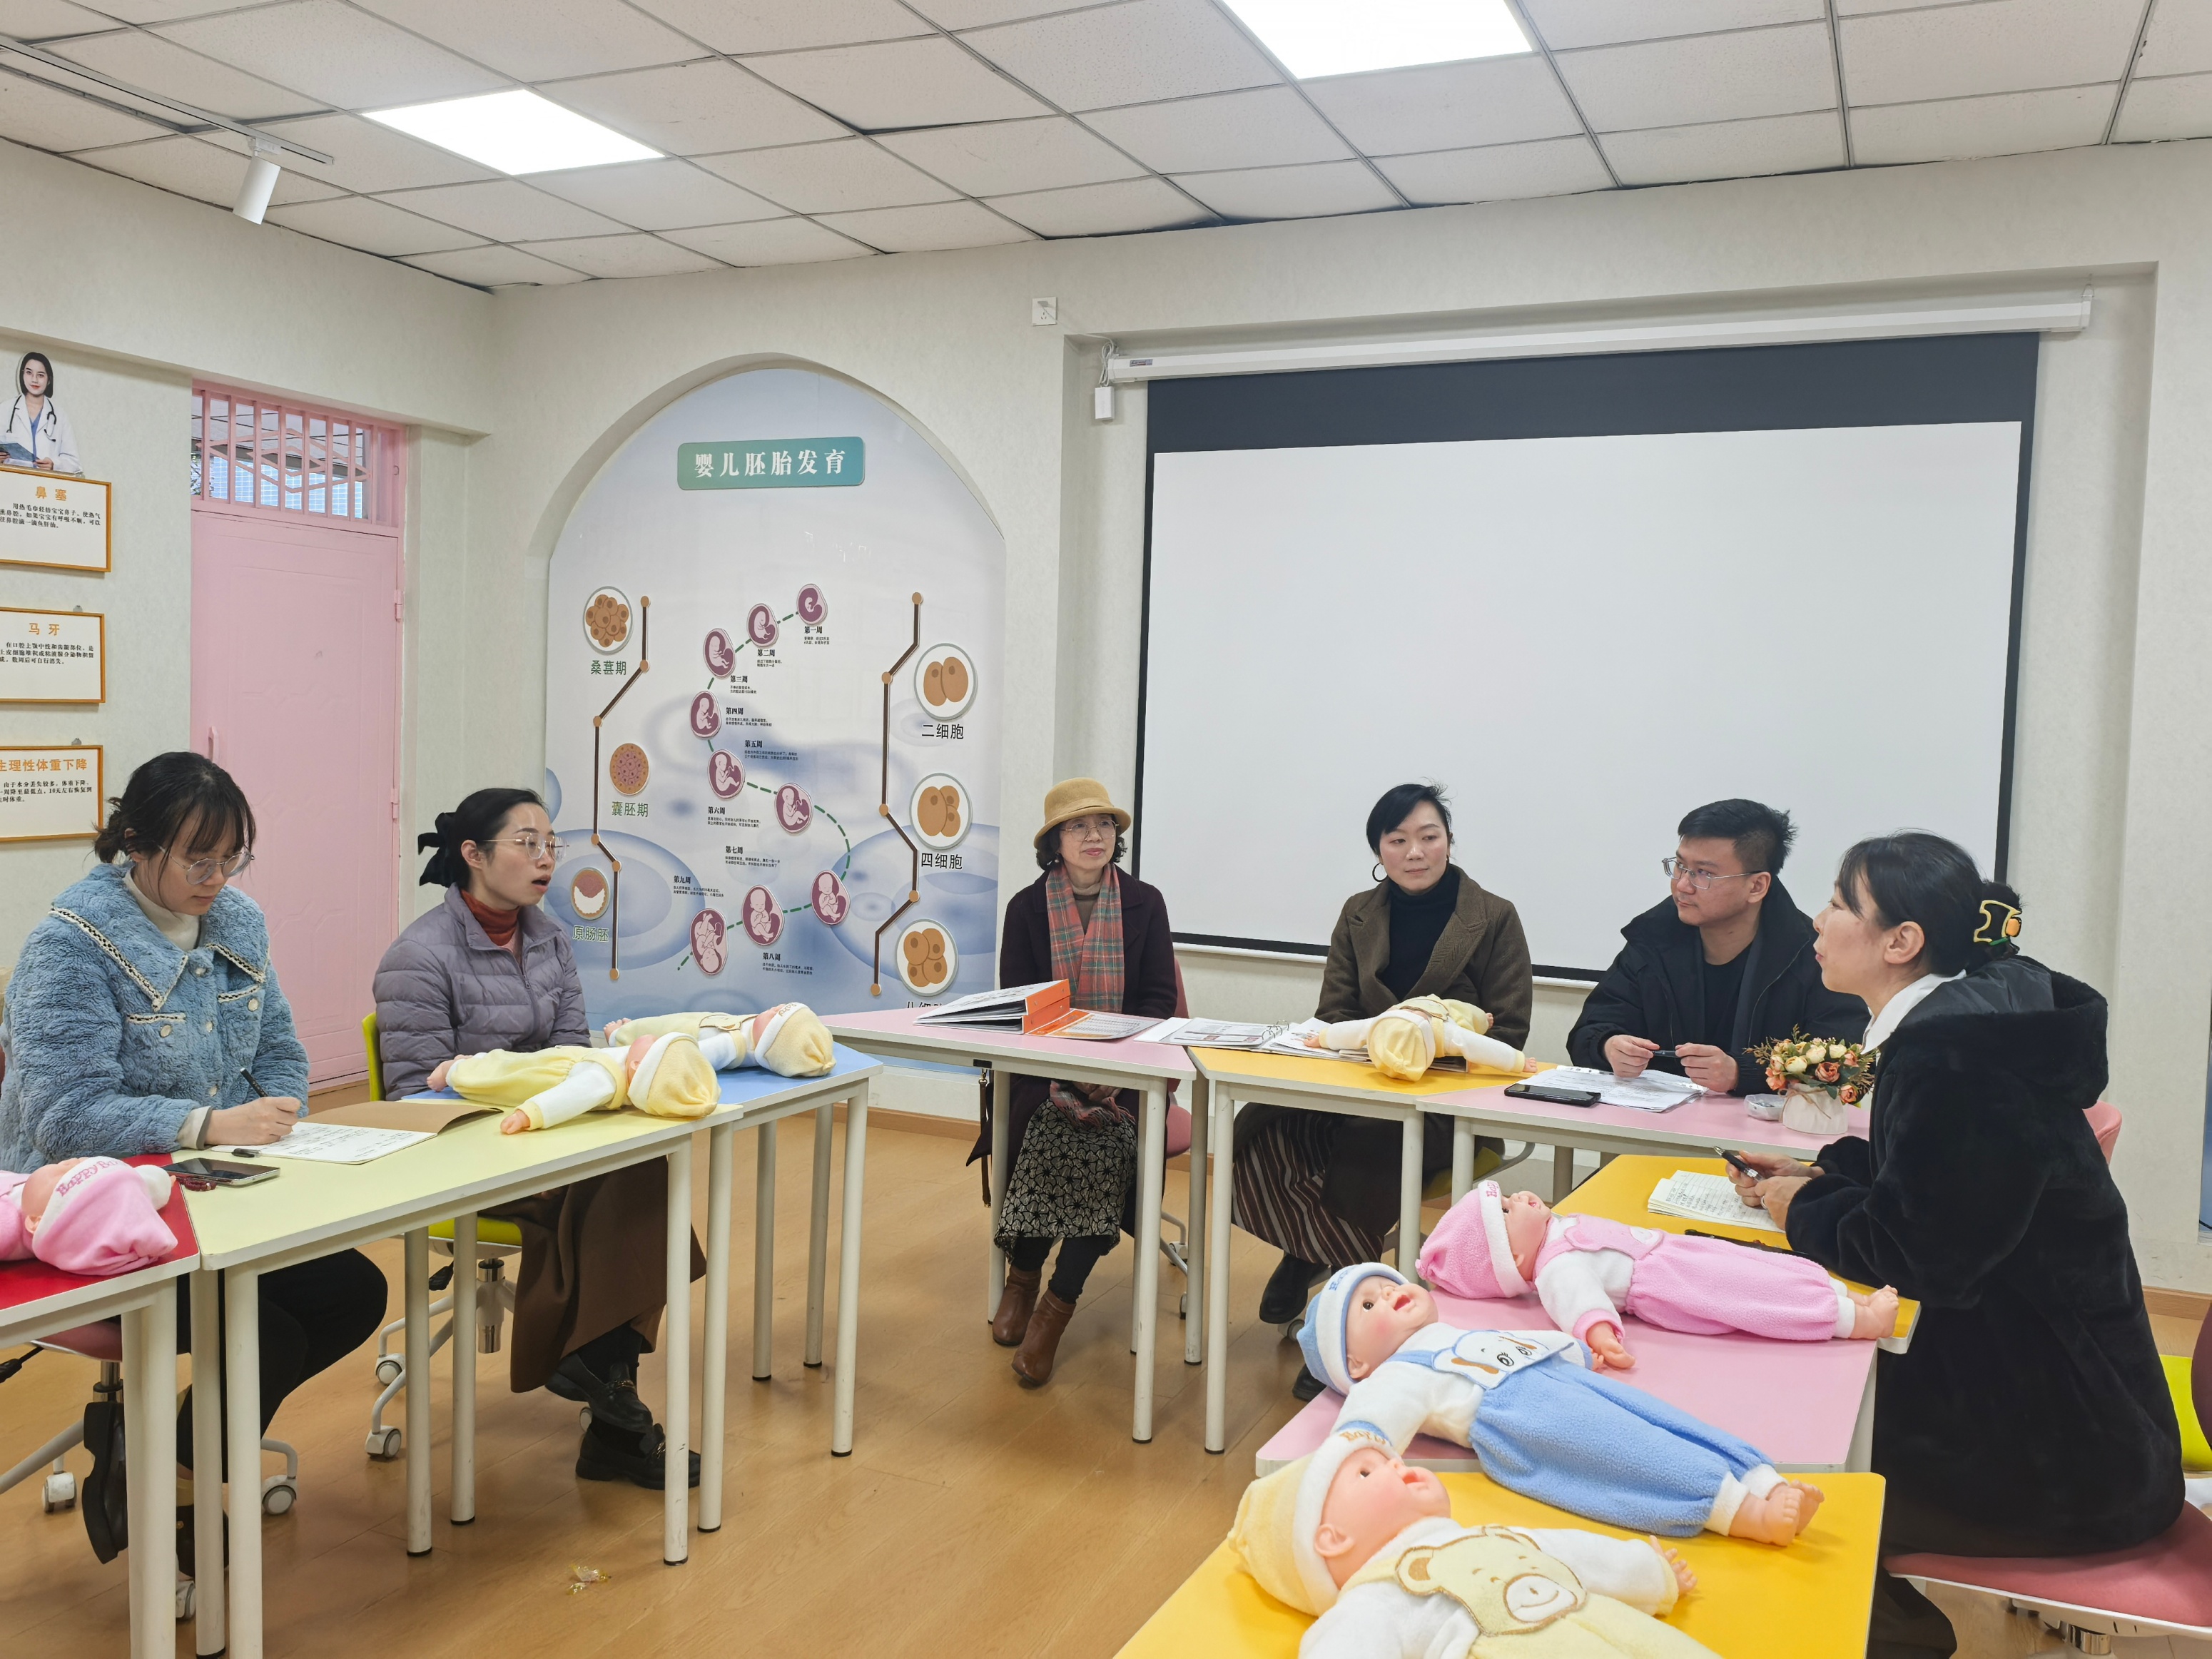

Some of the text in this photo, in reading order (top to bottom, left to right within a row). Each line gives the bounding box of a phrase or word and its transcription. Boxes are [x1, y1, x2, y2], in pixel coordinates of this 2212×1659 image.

[694, 449, 846, 478] 婴儿胚胎发育
[36, 486, 67, 501] 鼻塞
[29, 623, 60, 636] 马牙
[591, 660, 626, 675] 桑葚期
[922, 724, 964, 739] 二细胞
[0, 759, 87, 771] 生理性体重下降
[612, 801, 649, 817] 囊胚期
[708, 806, 726, 815] 第六周
[726, 846, 743, 854] 第七周
[921, 853, 963, 870] 四细胞
[674, 876, 691, 884] 第九周
[573, 925, 609, 941] 原肠胚
[763, 952, 781, 961] 第八周
